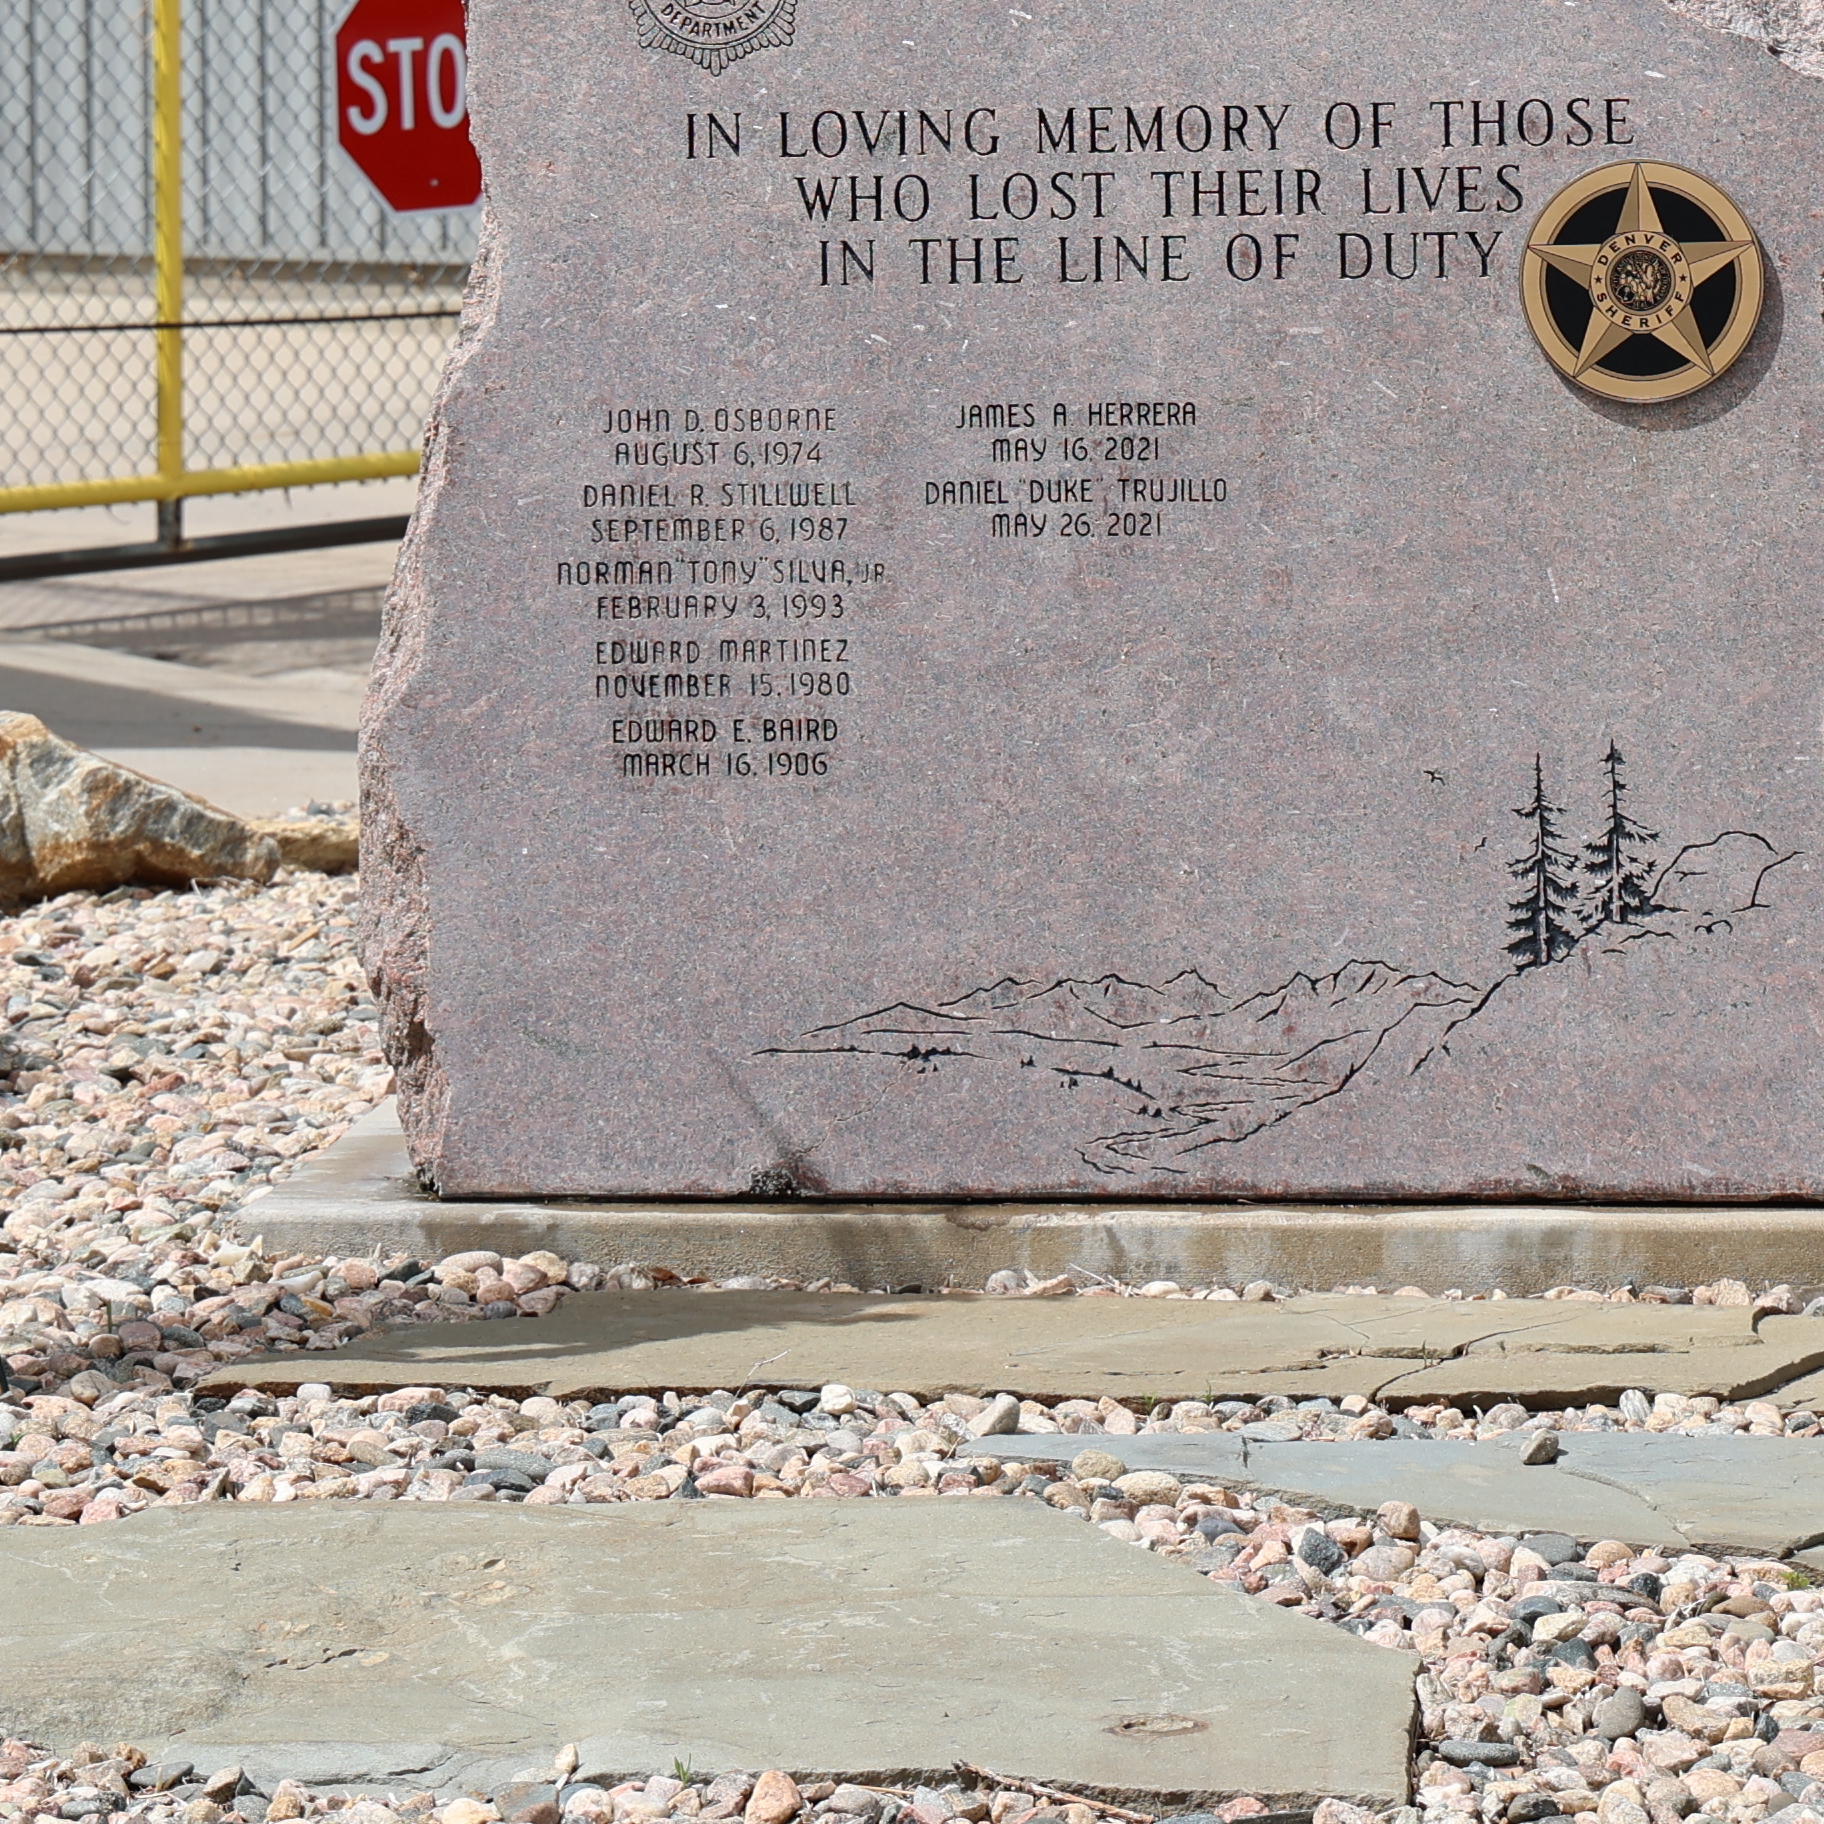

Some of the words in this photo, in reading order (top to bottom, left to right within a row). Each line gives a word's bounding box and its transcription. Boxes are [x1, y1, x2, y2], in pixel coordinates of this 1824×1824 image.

[660, 0, 767, 39] DEPARTMENT
[346, 32, 467, 136] STO
[686, 112, 741, 160] IN
[778, 108, 1000, 159] LOVING
[1037, 104, 1292, 154] MEMORY
[1325, 101, 1397, 151] OF
[1429, 97, 1636, 148] THOSE
[795, 173, 930, 223] WHO
[969, 171, 1115, 221] LOST
[1150, 168, 1326, 219] THEIR
[1362, 163, 1524, 216] LIVES
[819, 238, 876, 287] IN
[908, 236, 1024, 285] THE
[1058, 234, 1191, 283] LINE
[1225, 232, 1300, 282] OF
[1337, 229, 1503, 281] DUTY
[1597, 233, 1683, 266] DENVER
[1596, 290, 1685, 328] SHERIFF
[602, 409, 671, 434] JOHN
[685, 409, 705, 433] D.
[714, 407, 837, 433] OSBORNE
[956, 403, 1036, 429] JAMES
[1088, 402, 1196, 427] HERRERA
[615, 441, 720, 466] AUGUST
[992, 438, 1047, 463] MAY
[1104, 436, 1159, 461] 2021
[583, 483, 676, 508] DANIEL
[690, 483, 709, 508] R.
[721, 481, 857, 507] STILLWELL
[926, 479, 1009, 506] DANIEL
[1117, 477, 1227, 503] TRUJILLO
[591, 517, 745, 543] SEPTEMBER
[790, 517, 848, 542] 1987
[992, 513, 1047, 538] MAY
[1106, 512, 1161, 537] 2021
[597, 595, 738, 620] FEBRUARY
[783, 594, 844, 619] 1993
[596, 640, 701, 664] EDWARD
[719, 639, 849, 663] MARTINEZ
[595, 673, 732, 698] NOVEMBER
[790, 672, 850, 696] 1980
[612, 719, 717, 743] EDWARD
[733, 719, 752, 743] E.
[763, 718, 839, 743] BAIRD
[622, 752, 711, 777] MARCH
[768, 752, 828, 776] 1906
